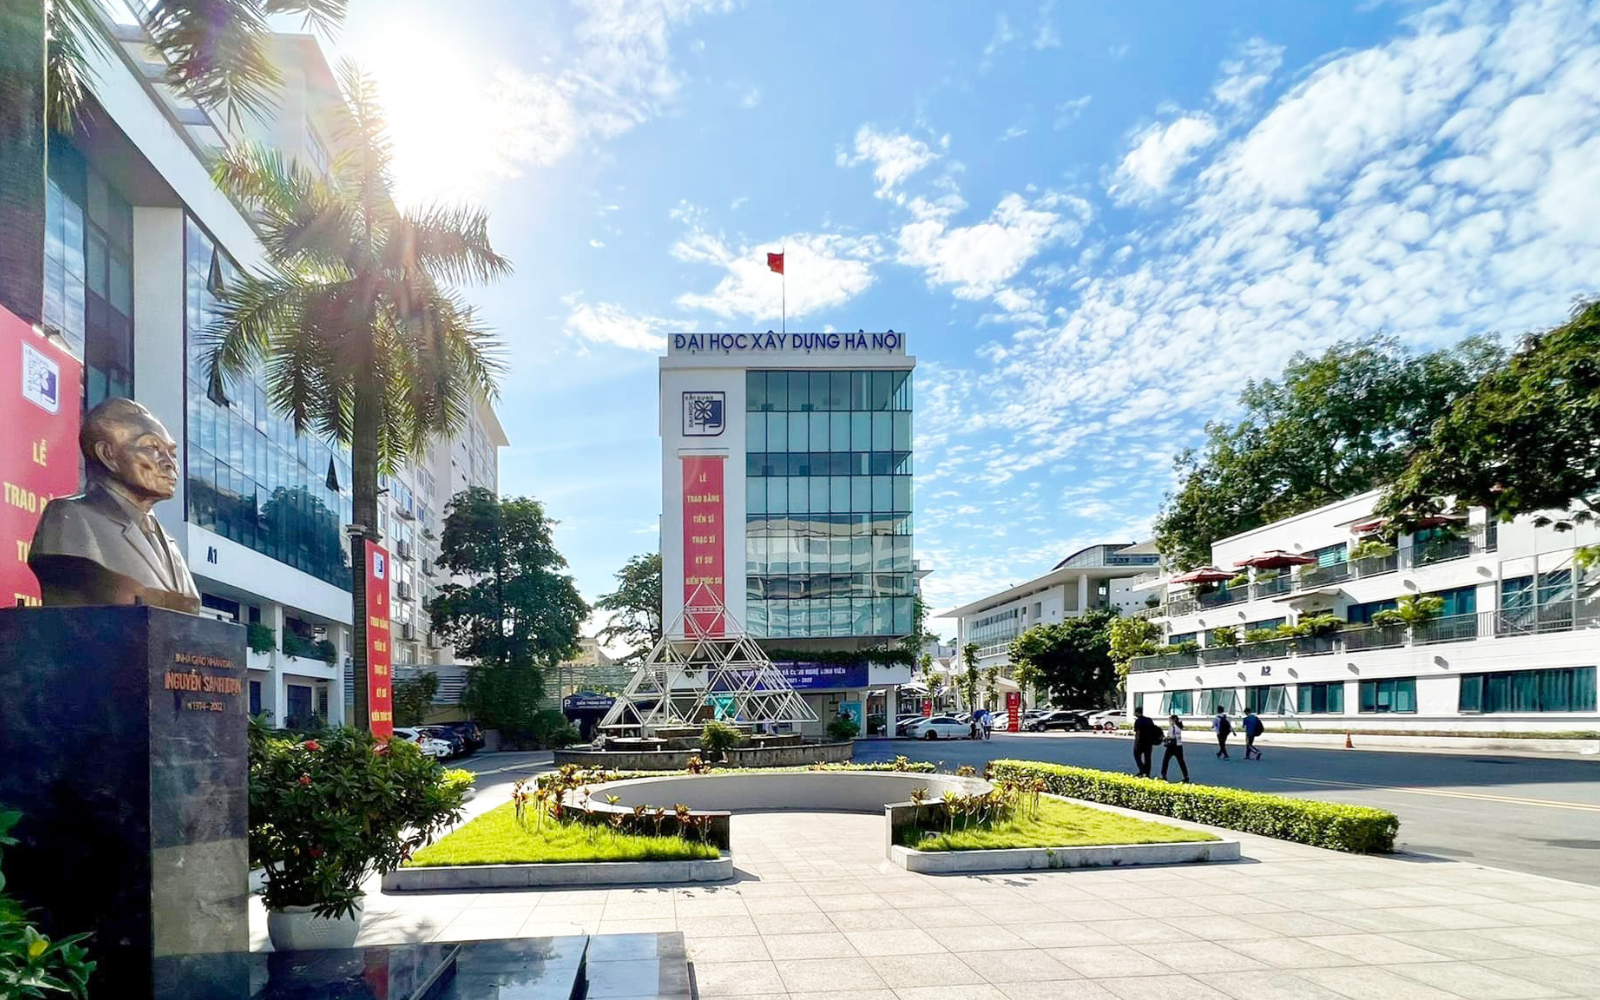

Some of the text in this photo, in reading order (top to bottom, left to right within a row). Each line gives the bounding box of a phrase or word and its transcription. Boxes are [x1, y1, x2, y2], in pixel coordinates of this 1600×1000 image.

[675, 328, 901, 355] ĐẠI HỌC XÂY DỰNG HÀ NỘI
[4, 481, 36, 513] TRAO
[207, 546, 217, 564] A1
